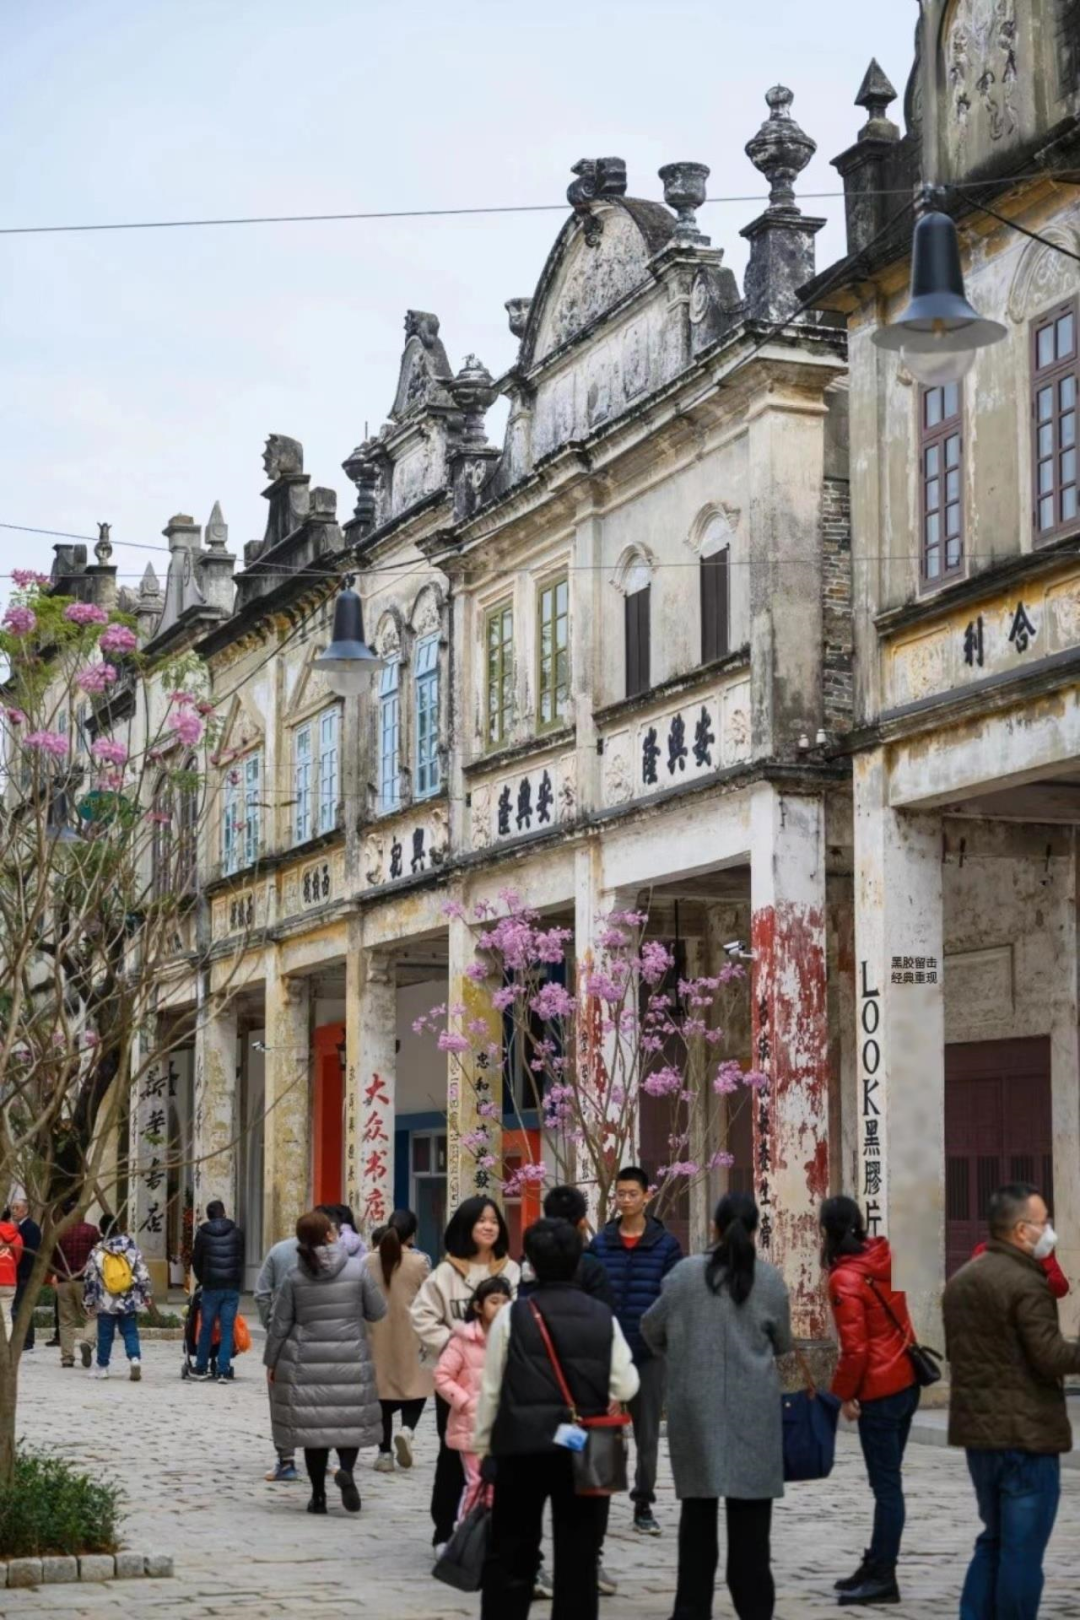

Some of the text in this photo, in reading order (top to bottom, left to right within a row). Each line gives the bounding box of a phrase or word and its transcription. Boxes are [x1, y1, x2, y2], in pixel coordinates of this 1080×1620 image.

[891, 971, 938, 985] 经典重现
[362, 1073, 390, 1222] 大众书店
